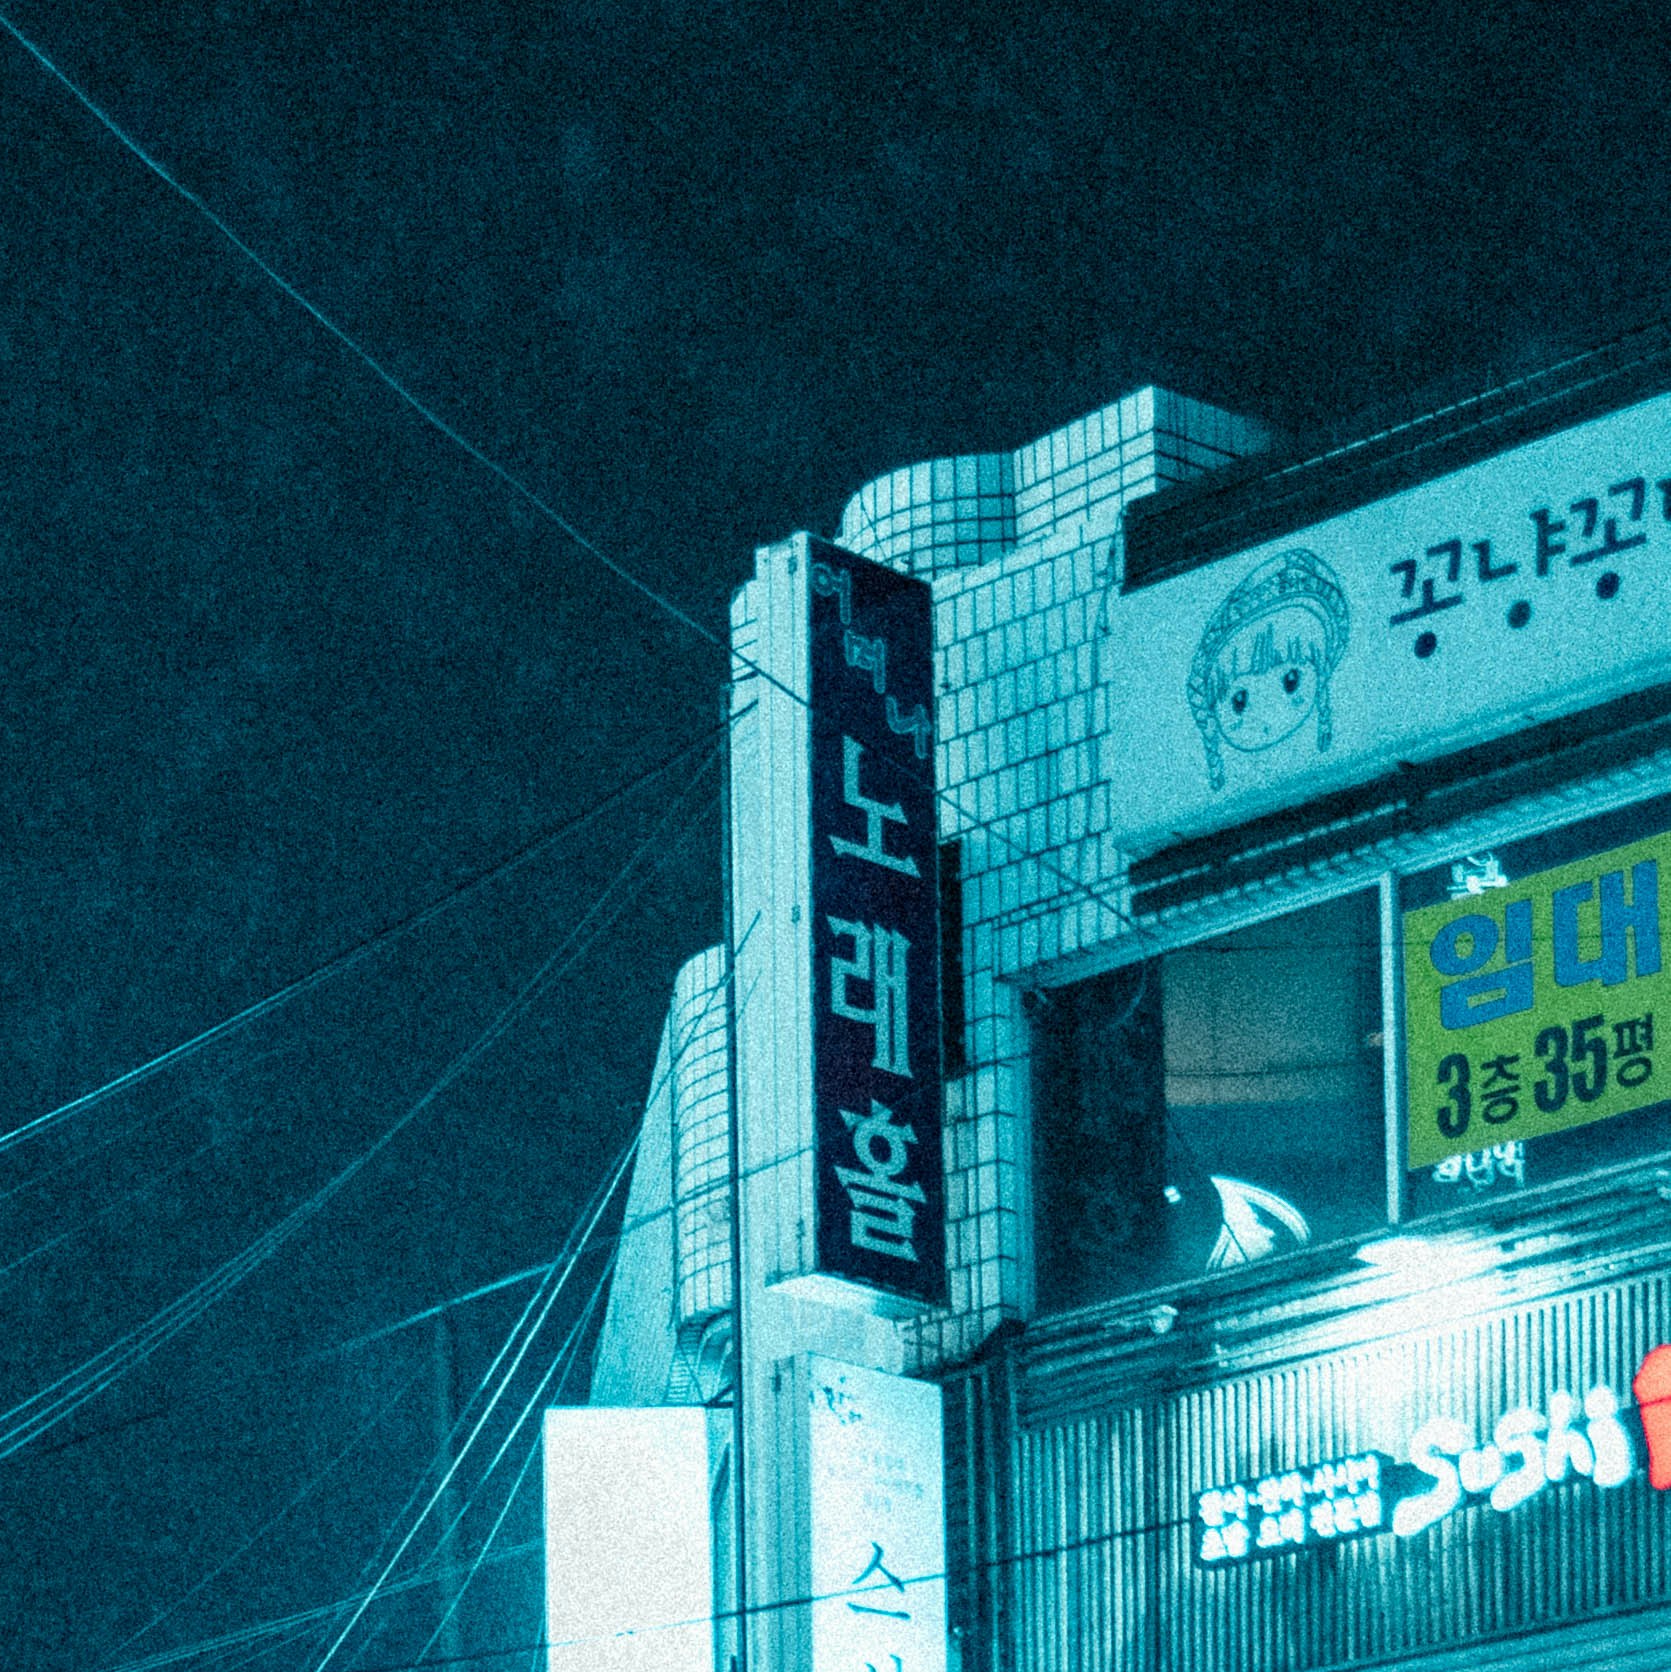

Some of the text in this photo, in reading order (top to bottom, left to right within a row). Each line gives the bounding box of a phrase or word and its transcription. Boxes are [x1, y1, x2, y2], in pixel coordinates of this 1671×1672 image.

[831, 736, 927, 1261] 노래홀
[1430, 860, 1661, 1030] 임대
[1437, 1013, 1654, 1138] 3층 35평
